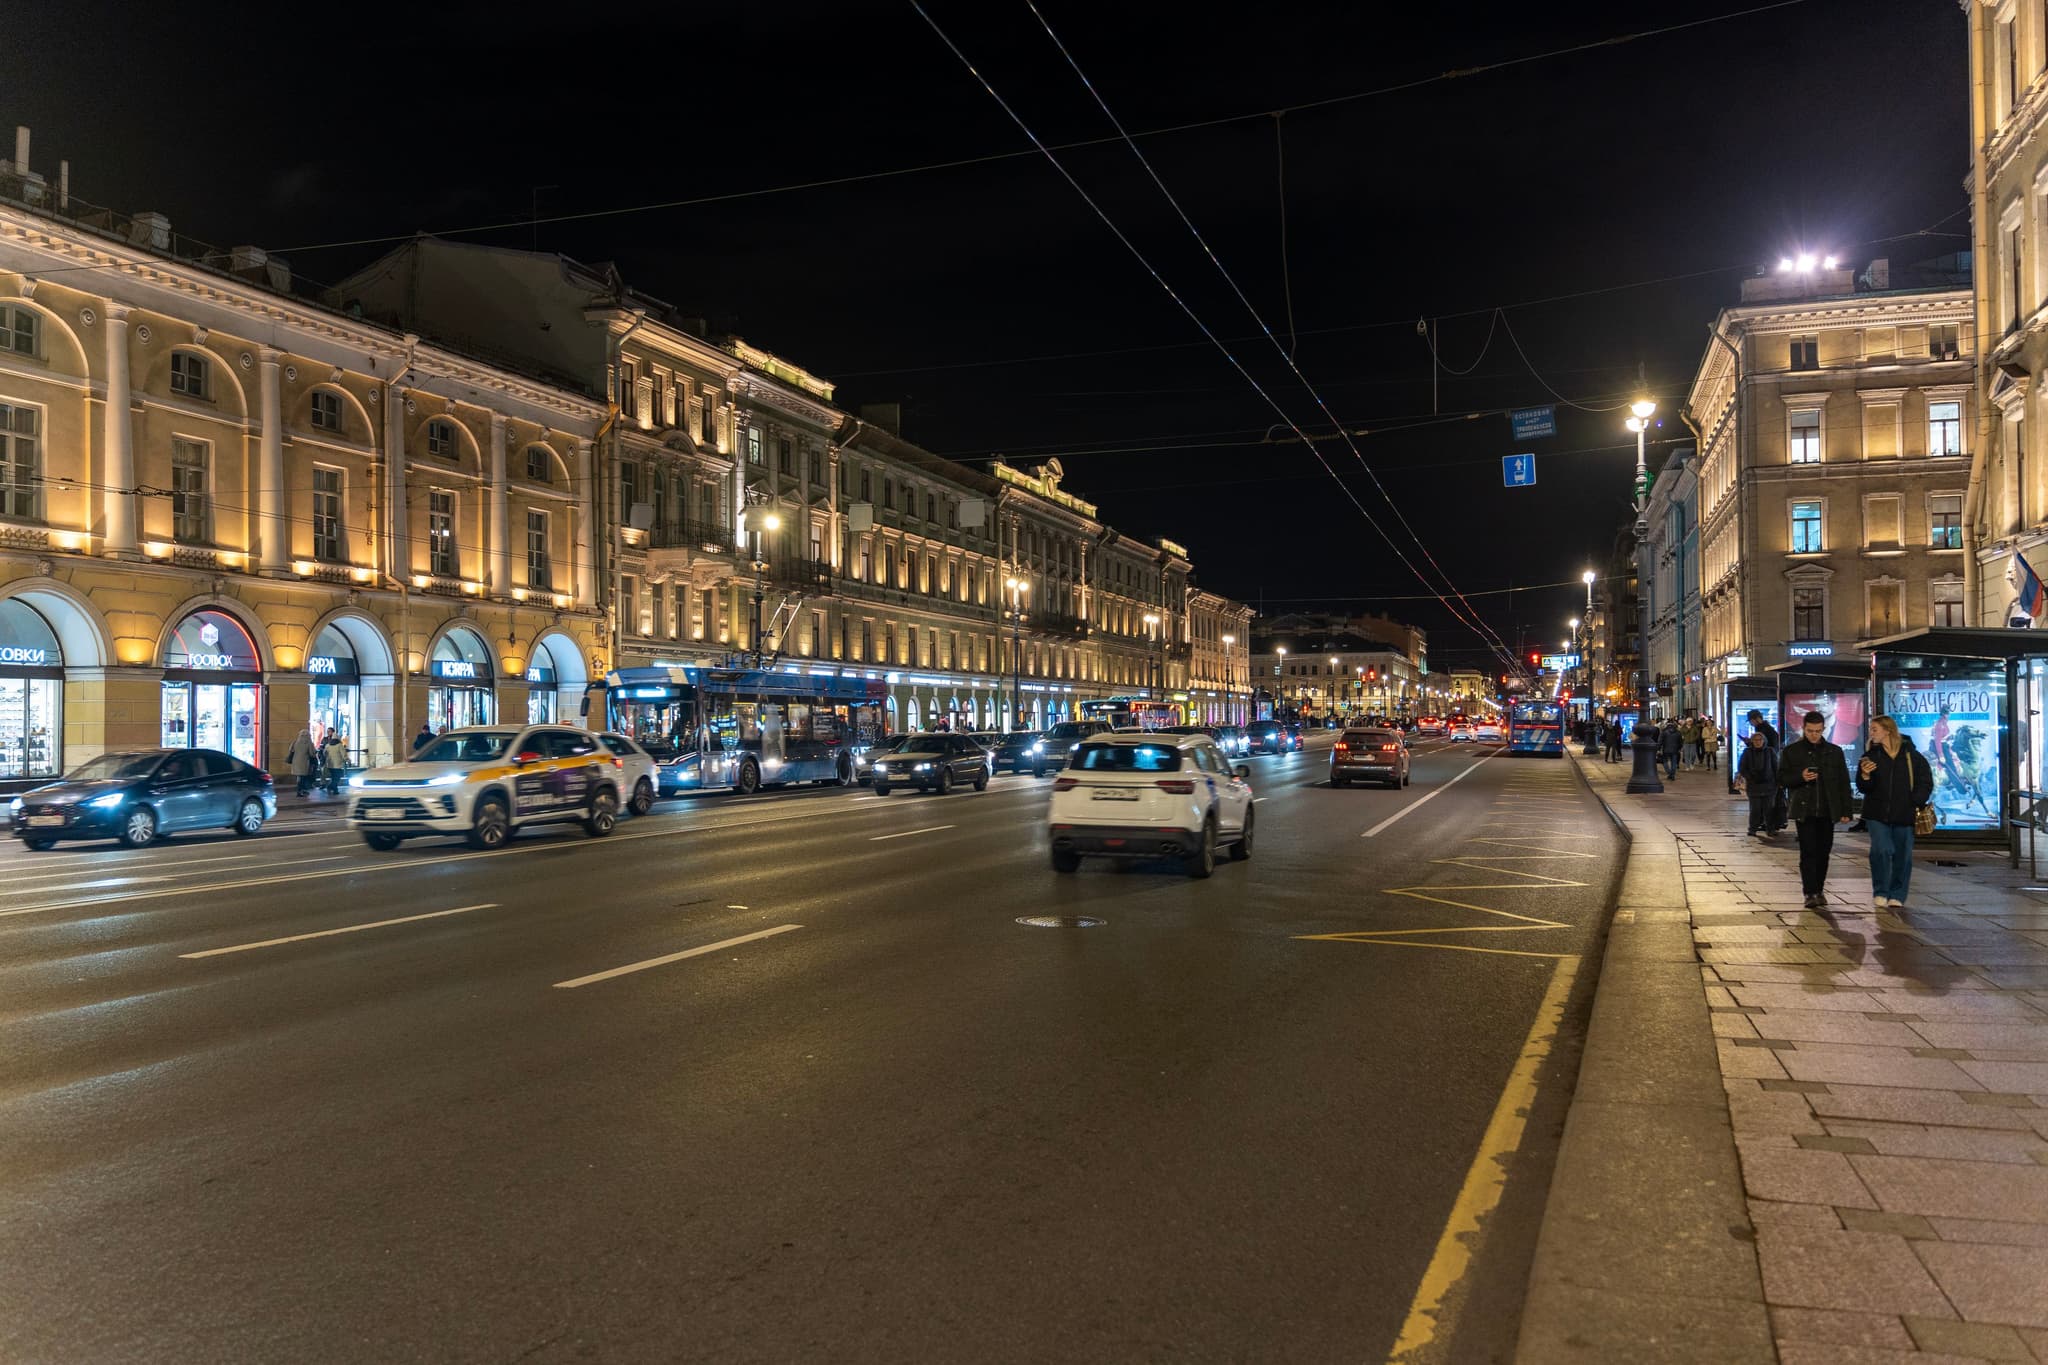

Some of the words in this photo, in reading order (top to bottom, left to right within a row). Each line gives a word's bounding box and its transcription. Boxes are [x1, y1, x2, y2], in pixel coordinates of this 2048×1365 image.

[0, 647, 45, 662] ОВКИ
[1790, 647, 1832, 656] INCANTO
[188, 653, 233, 667] FOOTBOX
[1887, 691, 1990, 713] КАЗАЧЕСТВО
